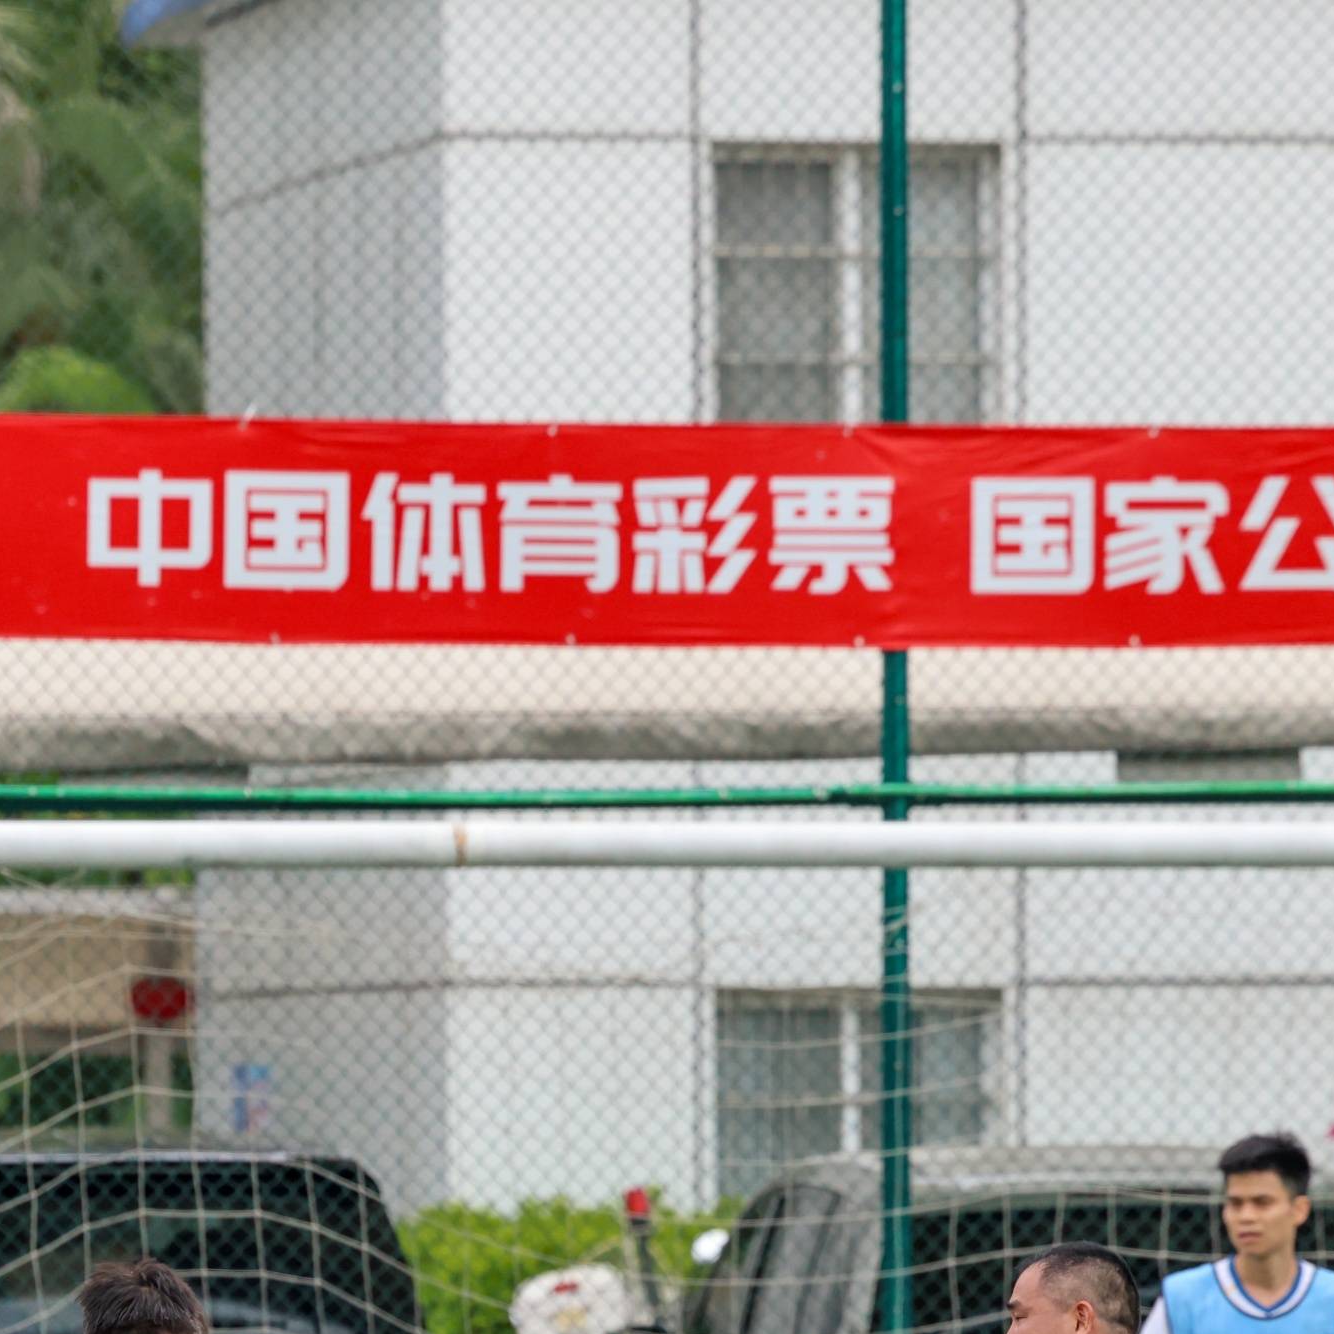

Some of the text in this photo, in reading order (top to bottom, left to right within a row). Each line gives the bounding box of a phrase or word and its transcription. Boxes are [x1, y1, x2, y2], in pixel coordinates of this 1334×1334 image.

[86, 468, 896, 595] 中国体育彩票
